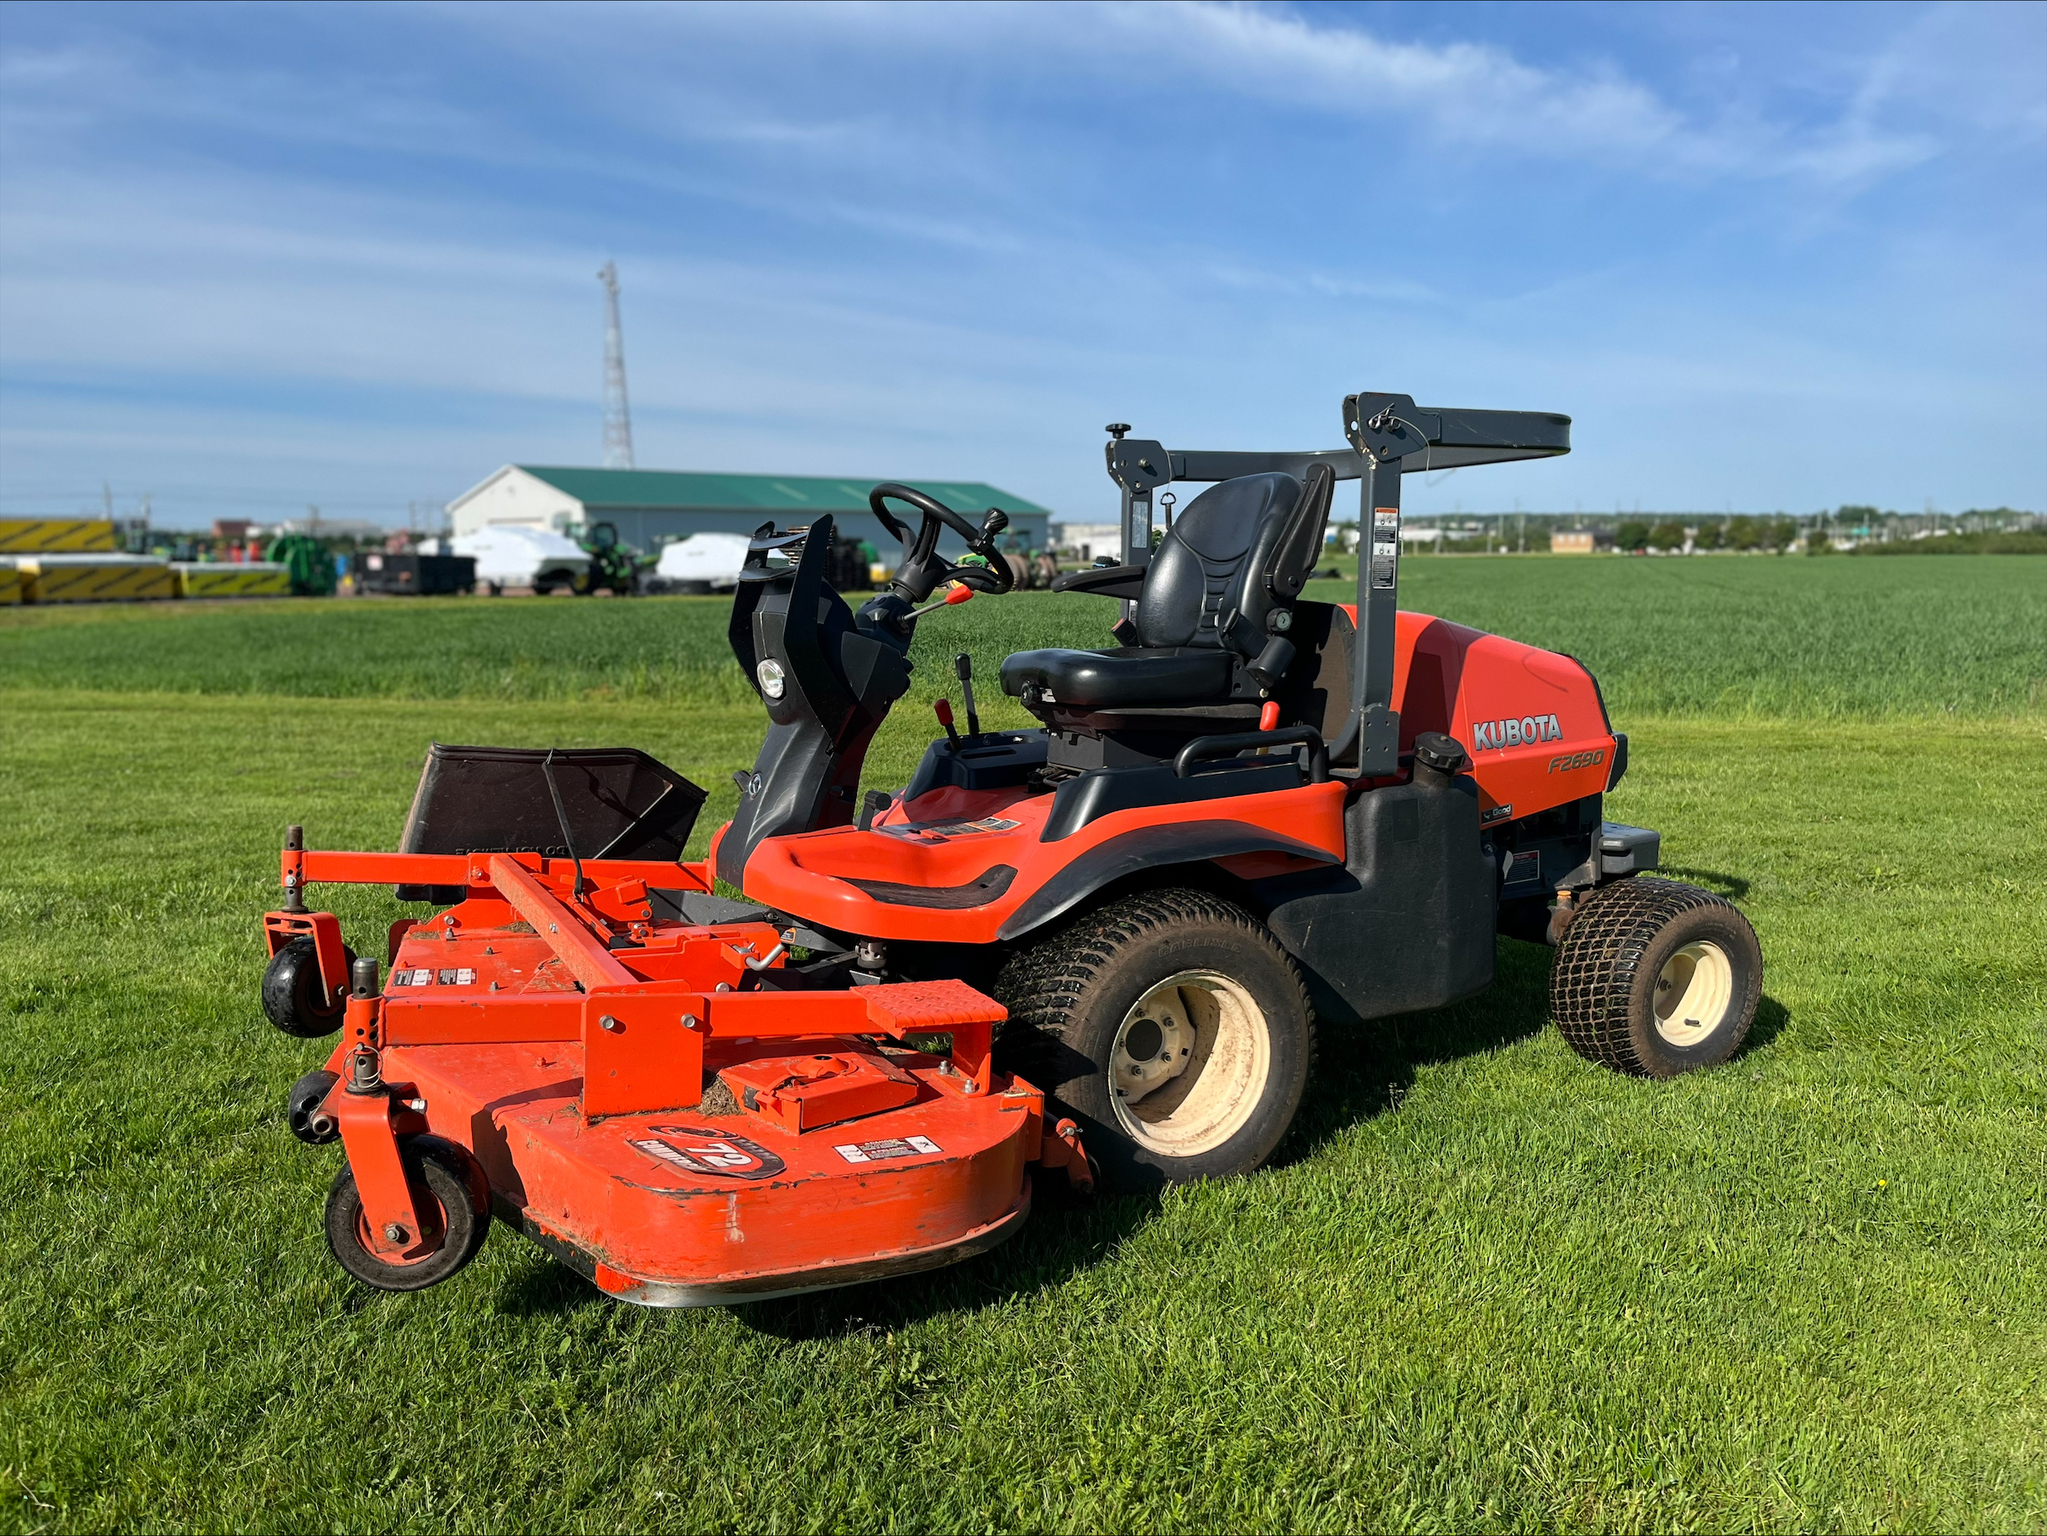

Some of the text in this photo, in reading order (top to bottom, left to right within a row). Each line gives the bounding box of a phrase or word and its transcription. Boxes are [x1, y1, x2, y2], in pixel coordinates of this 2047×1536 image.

[1473, 713, 1563, 751] KUBOTA
[1547, 749, 1605, 774] F2690
[1158, 937, 1243, 958] CARLISLE
[685, 1142, 752, 1167] 72
